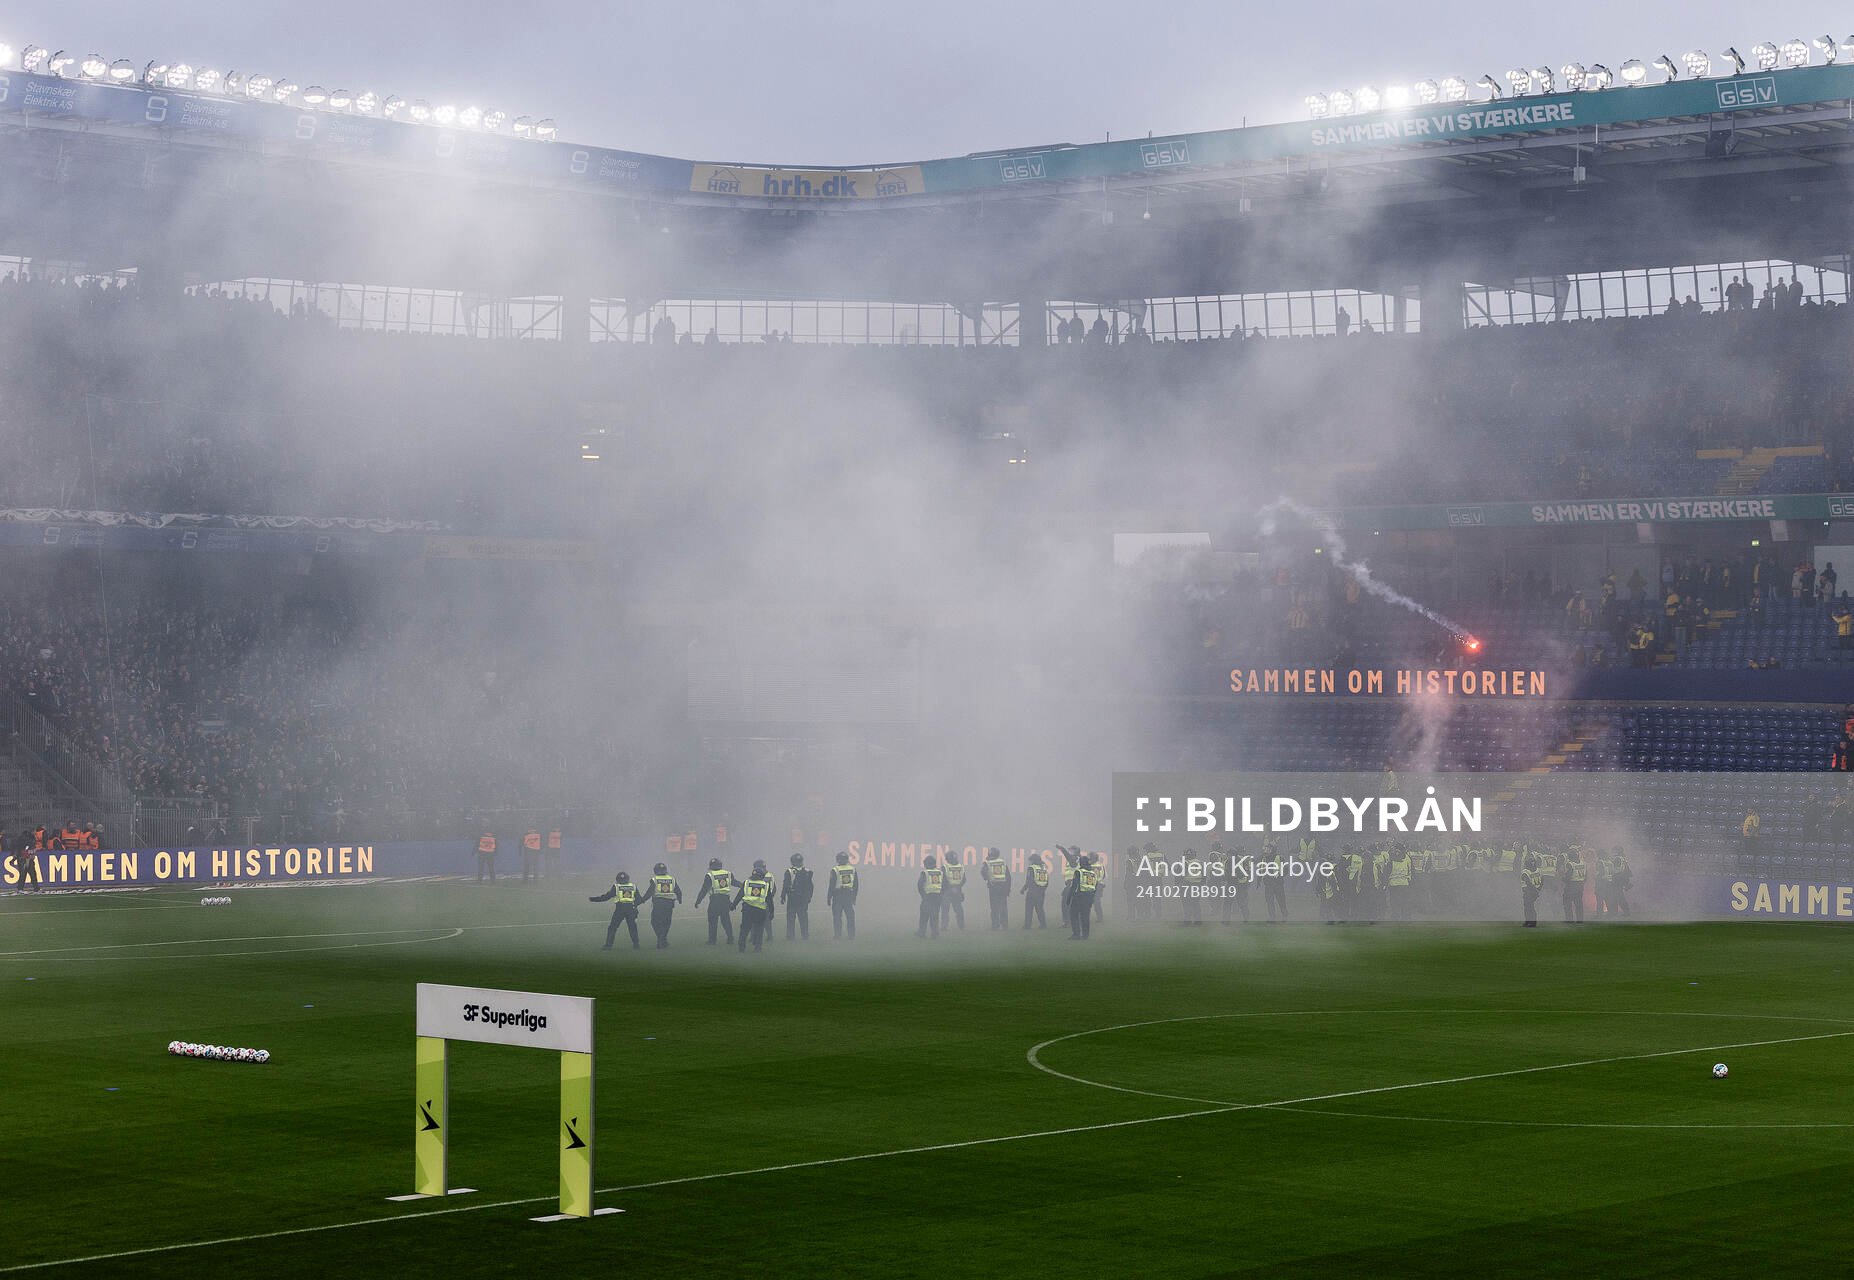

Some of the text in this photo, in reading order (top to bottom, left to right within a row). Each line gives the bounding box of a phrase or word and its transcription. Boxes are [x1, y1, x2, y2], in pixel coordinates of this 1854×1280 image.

[26, 81, 76, 97] Stavnskær
[1720, 86, 1773, 106] GSV
[24, 94, 74, 110] Elektrik A/S
[1311, 102, 1575, 146] SAMMEN ER VI STÆRKERE
[1144, 148, 1186, 165] GSV
[1002, 163, 1042, 179] GSV
[707, 180, 741, 193] HRH
[763, 173, 858, 197] hrh.dk
[875, 181, 908, 196] HRH
[1450, 511, 1482, 525] GSV
[1531, 499, 1776, 523] SAMMEN ER VI STÆRKERE
[1230, 669, 1545, 695] SAMMEN OM HISTORIEN
[154, 851, 196, 879] OM
[212, 847, 373, 878] HISTORIEN
[1731, 881, 1854, 917] SAMME
[463, 1004, 547, 1032] 3F Superliga
